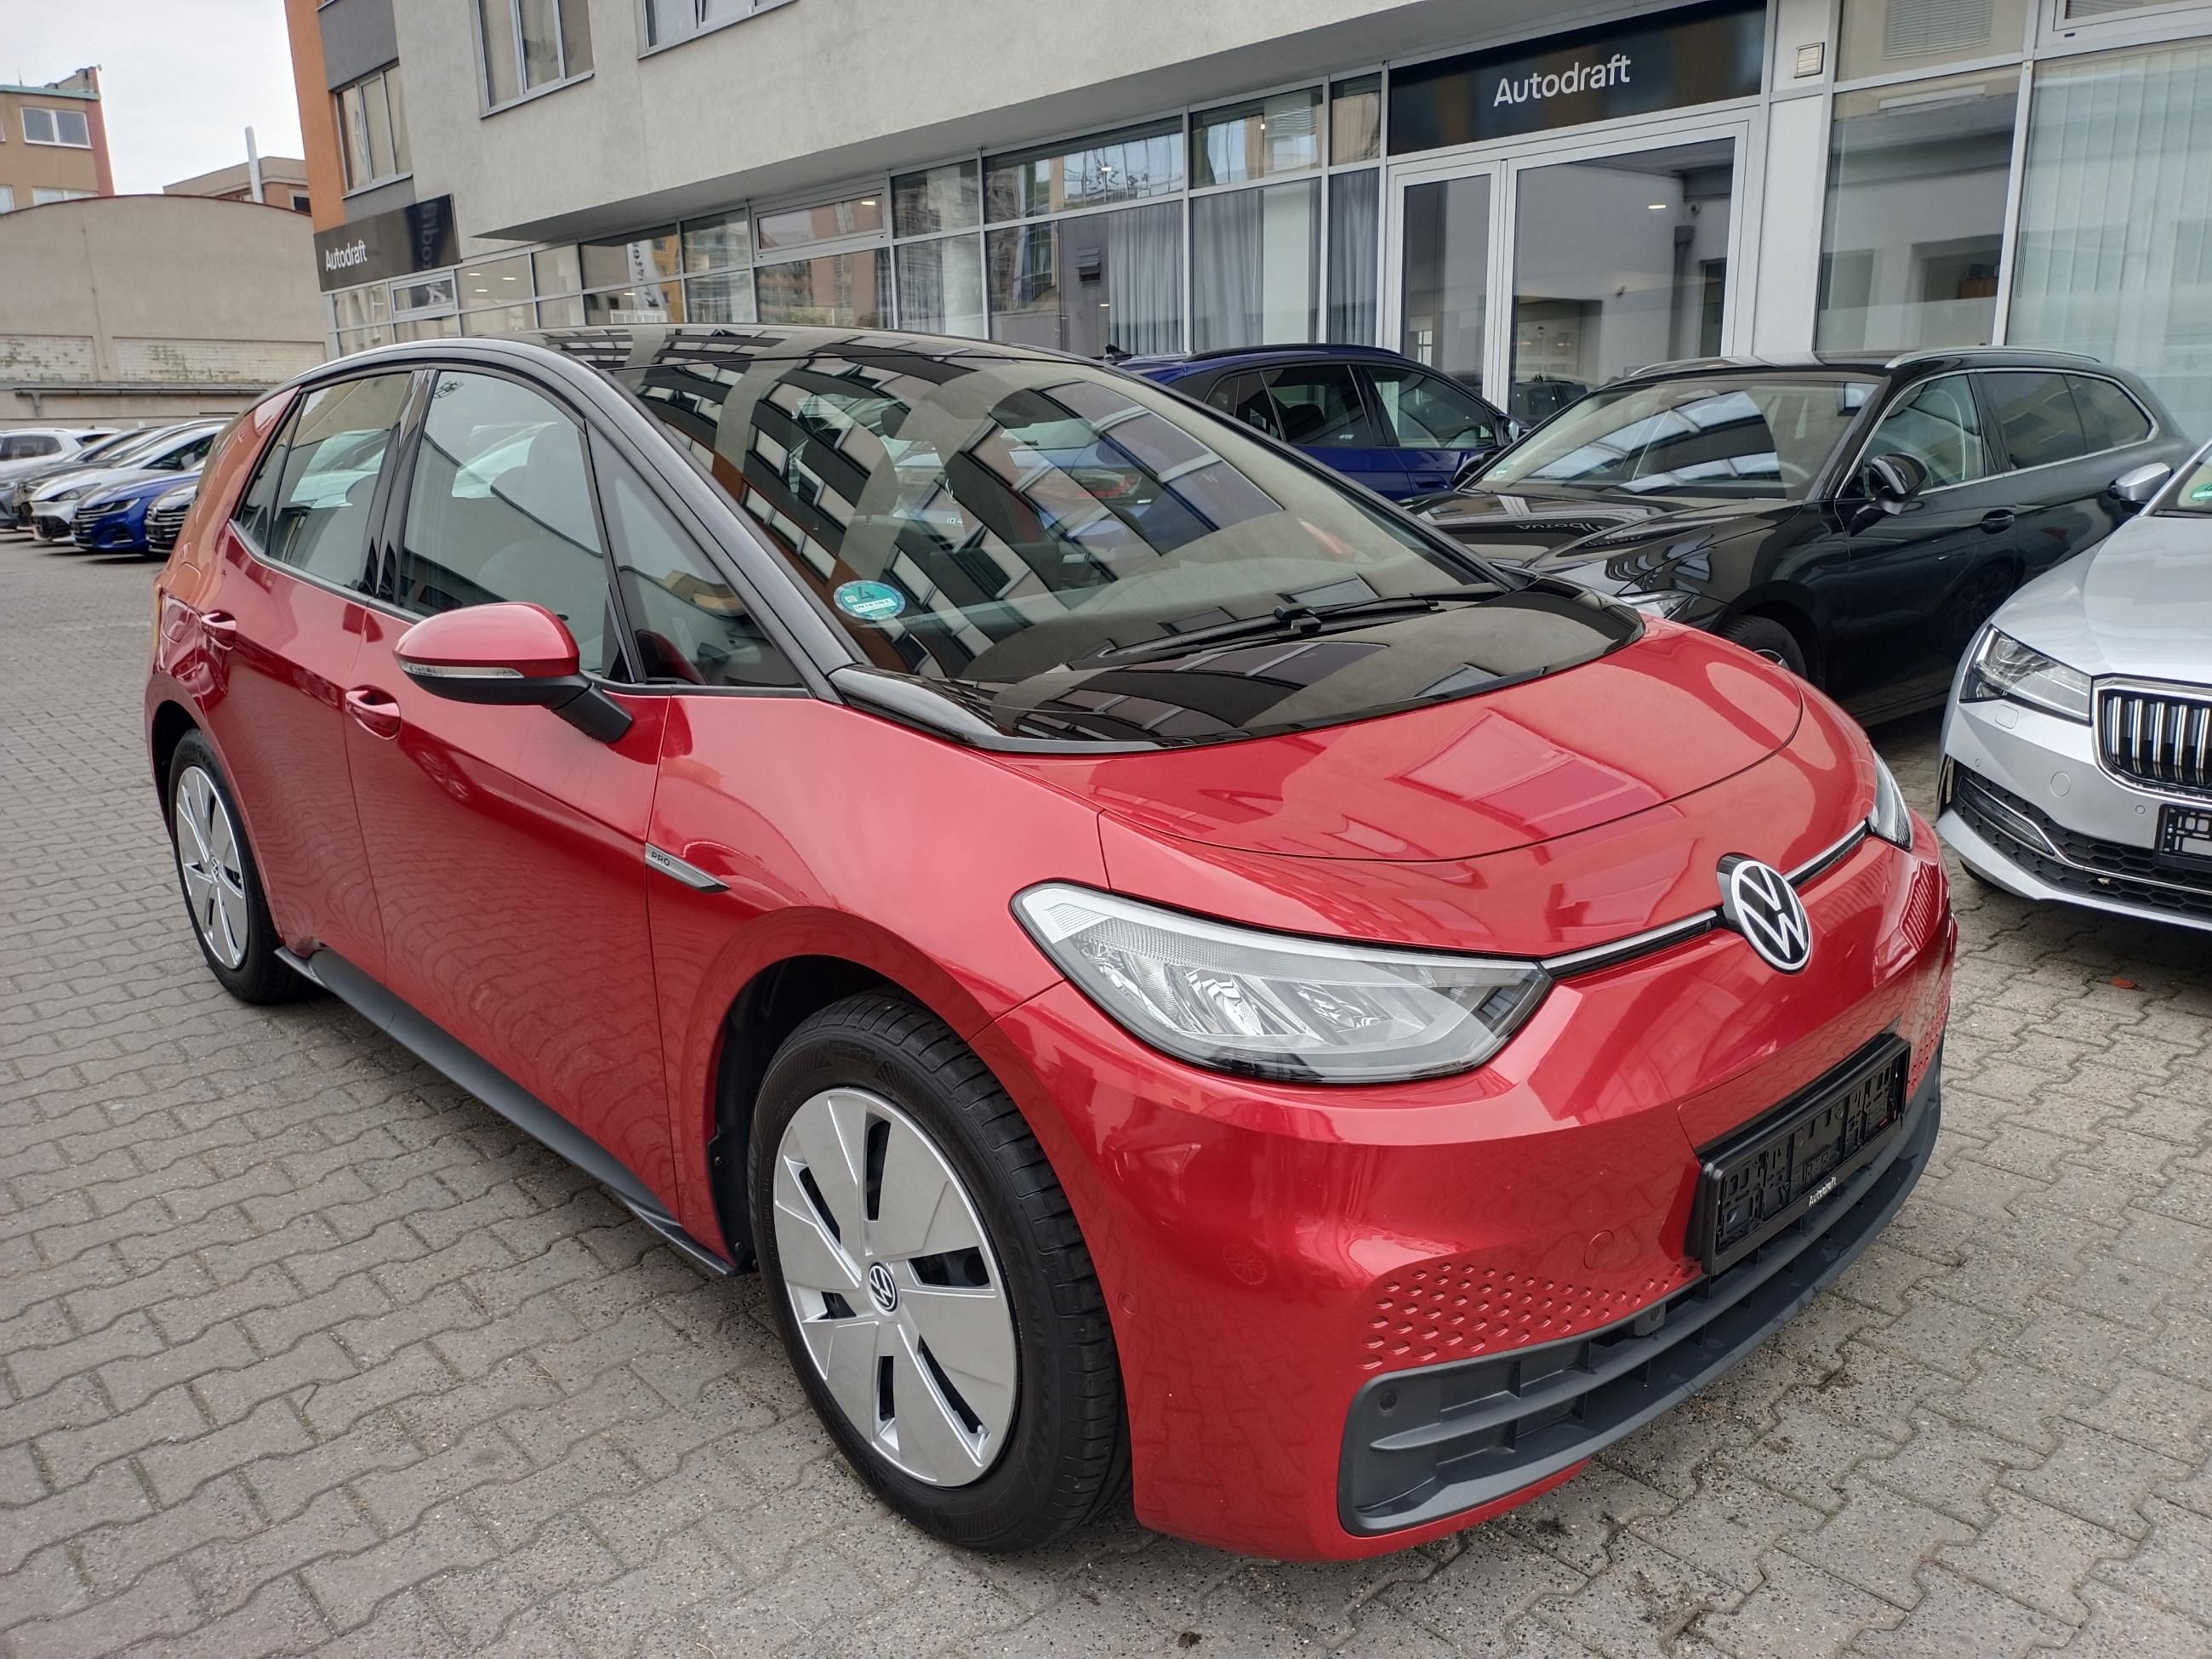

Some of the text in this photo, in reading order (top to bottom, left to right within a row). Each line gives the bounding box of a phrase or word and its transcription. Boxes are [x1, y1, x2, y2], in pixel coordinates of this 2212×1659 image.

[1494, 54, 1631, 107] Autodraft
[325, 239, 368, 271] Autodraft
[651, 851, 670, 867] PRO
